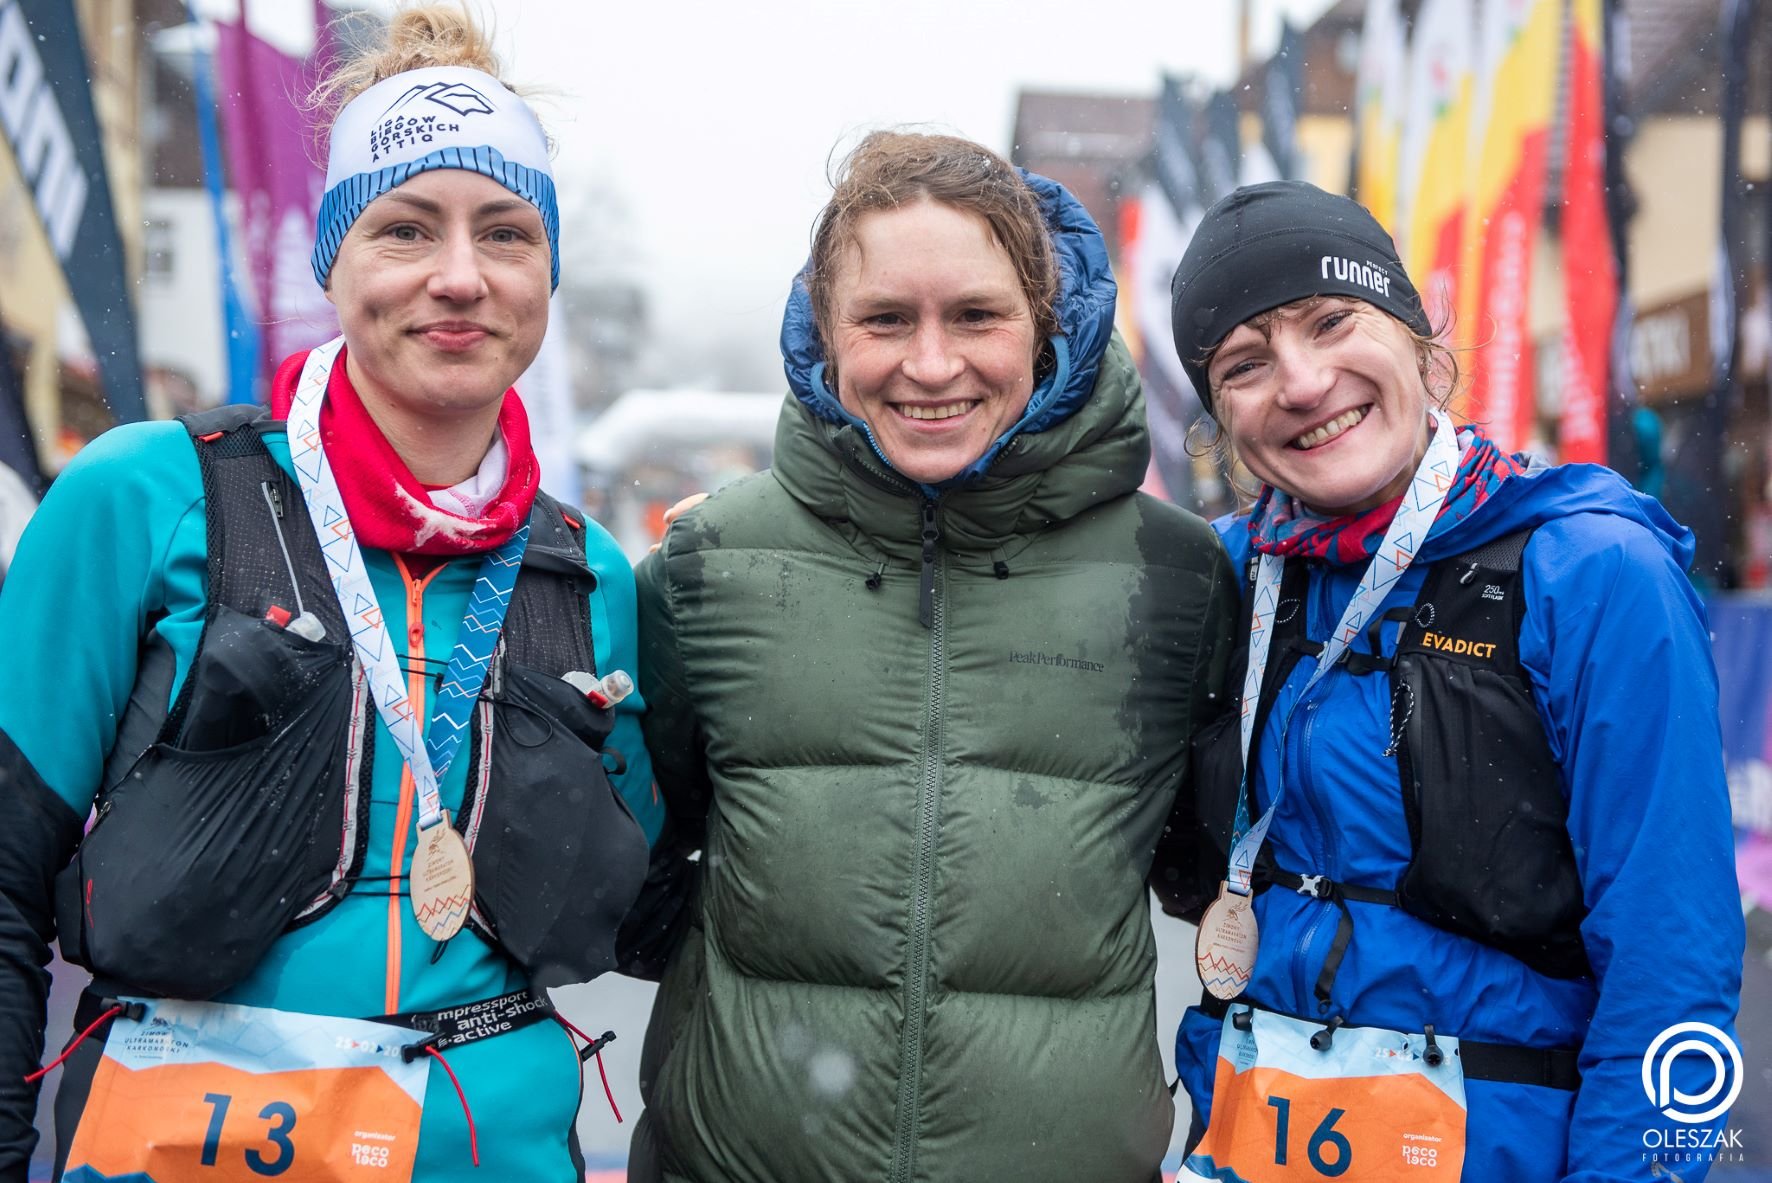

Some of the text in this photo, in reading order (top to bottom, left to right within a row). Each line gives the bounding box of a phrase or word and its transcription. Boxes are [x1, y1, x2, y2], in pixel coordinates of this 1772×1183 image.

[371, 115, 404, 137] LIGA
[372, 134, 433, 163] ATTIQ
[1321, 256, 1391, 298] runner
[1422, 632, 1496, 658] EVADICT
[437, 991, 528, 1021] mpressport
[457, 996, 549, 1030] anti-shock
[125, 1038, 189, 1048] ULTRAMARTON
[127, 1045, 181, 1053] KARKONOKI
[200, 1092, 297, 1177] 13
[1267, 1095, 1352, 1177] 16
